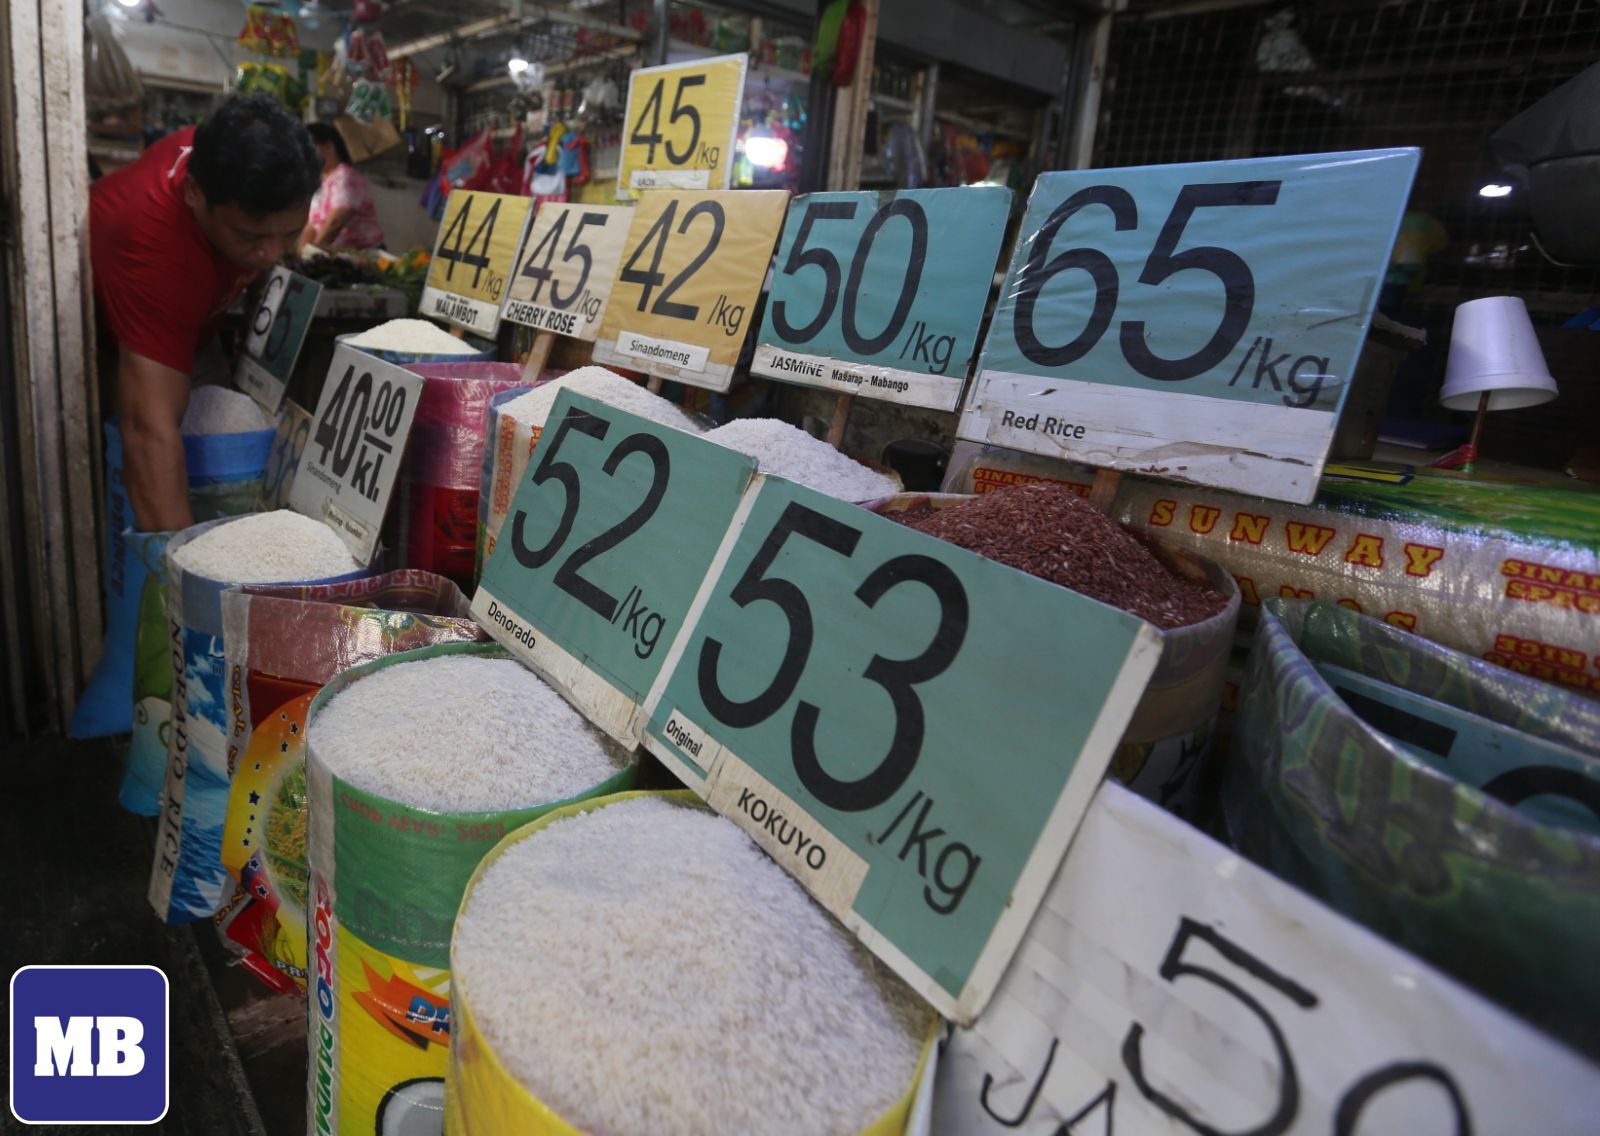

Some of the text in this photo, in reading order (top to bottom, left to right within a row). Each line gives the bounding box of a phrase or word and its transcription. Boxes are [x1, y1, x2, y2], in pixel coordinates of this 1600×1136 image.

[619, 199, 746, 336] 42 /kg
[771, 198, 957, 375] 50 /kg
[1013, 180, 1330, 408] 65 /kg
[506, 302, 577, 335] CHERRY ROSE
[629, 339, 691, 366] Sinandomeng
[770, 355, 824, 378] JASMINE
[870, 375, 909, 392] Mabango
[1001, 410, 1086, 440] Red Rice
[510, 405, 671, 659] 52 /kg
[1150, 499, 1444, 577] SUNWAY
[487, 601, 536, 650] Denorado
[665, 718, 703, 758] Original
[697, 500, 982, 916] 53 /kg
[161, 797, 181, 877] RICE
[737, 787, 827, 870] KOKUYO
[315, 872, 334, 1021] COCO
